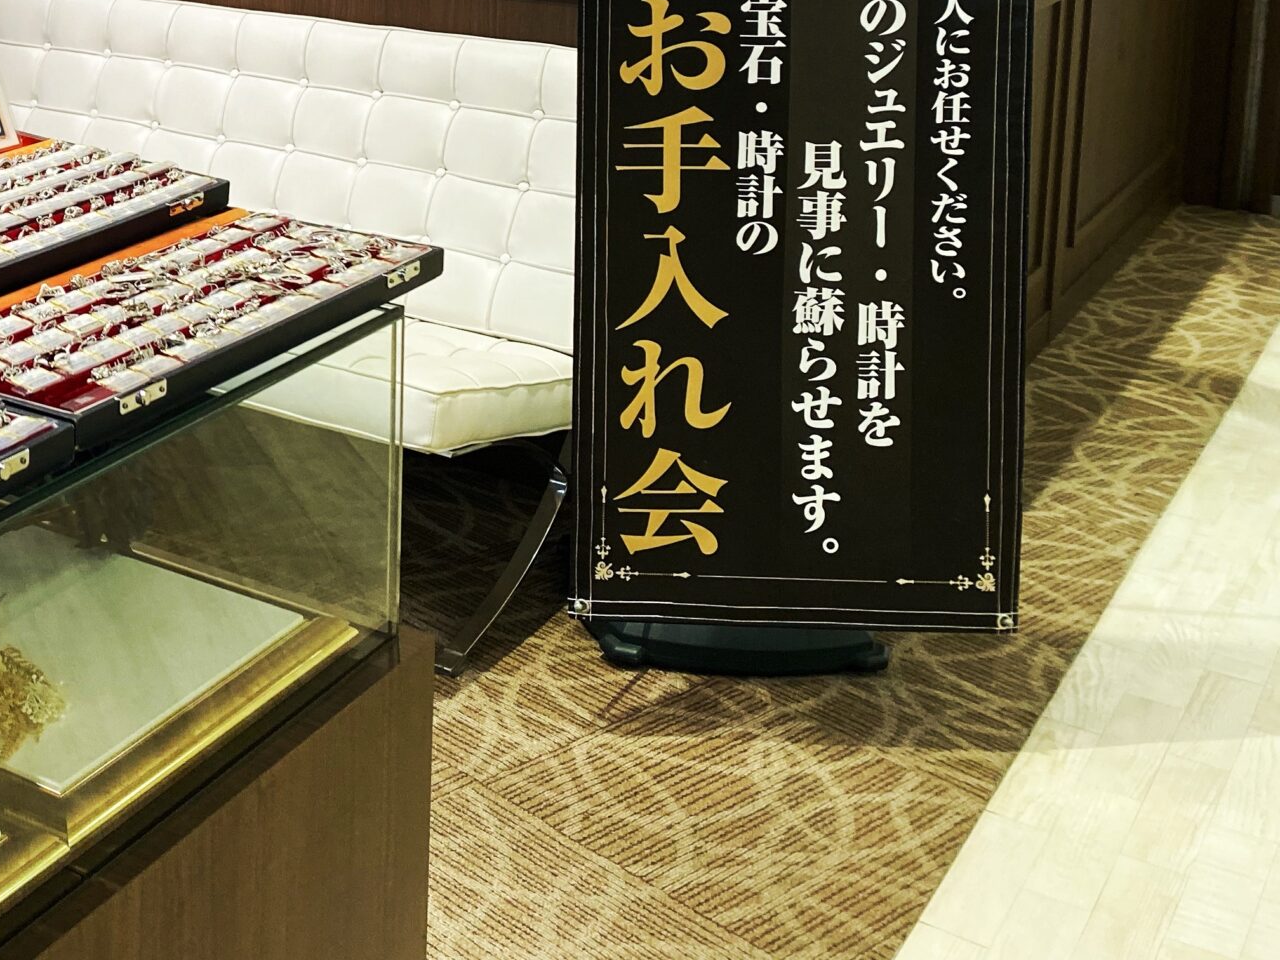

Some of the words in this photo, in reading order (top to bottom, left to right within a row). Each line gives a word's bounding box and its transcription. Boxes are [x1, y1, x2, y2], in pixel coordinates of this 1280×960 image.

[791, 140, 848, 554] 見事に蘇らせます。
